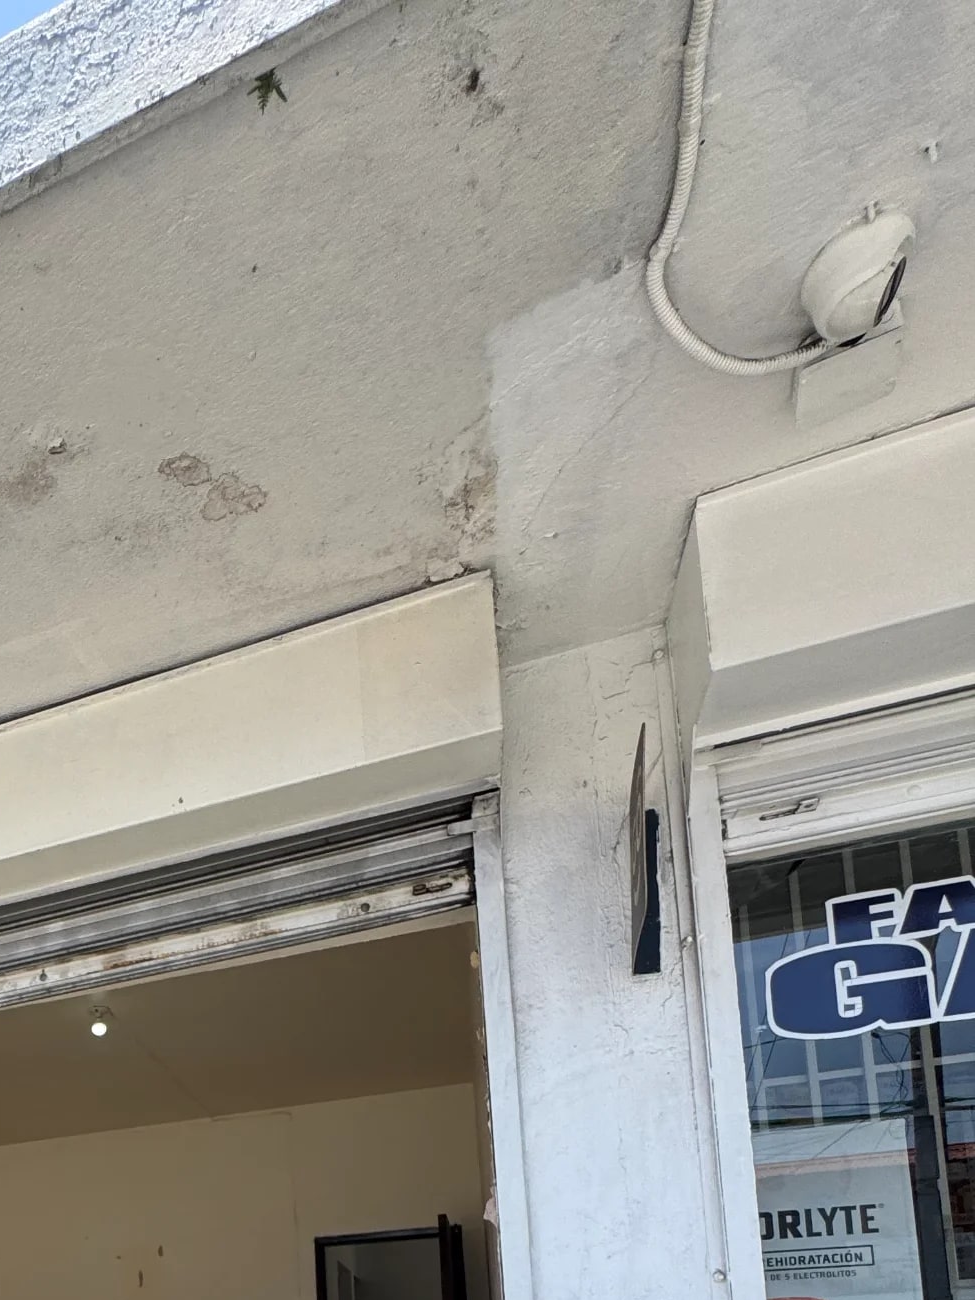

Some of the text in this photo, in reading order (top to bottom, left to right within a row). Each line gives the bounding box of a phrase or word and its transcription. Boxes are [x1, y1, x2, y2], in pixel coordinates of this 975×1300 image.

[763, 1249, 864, 1268] EHIDRATACIÓN
[770, 1273, 782, 1281] DE
[793, 1269, 858, 1280] ELECTROLITOS
